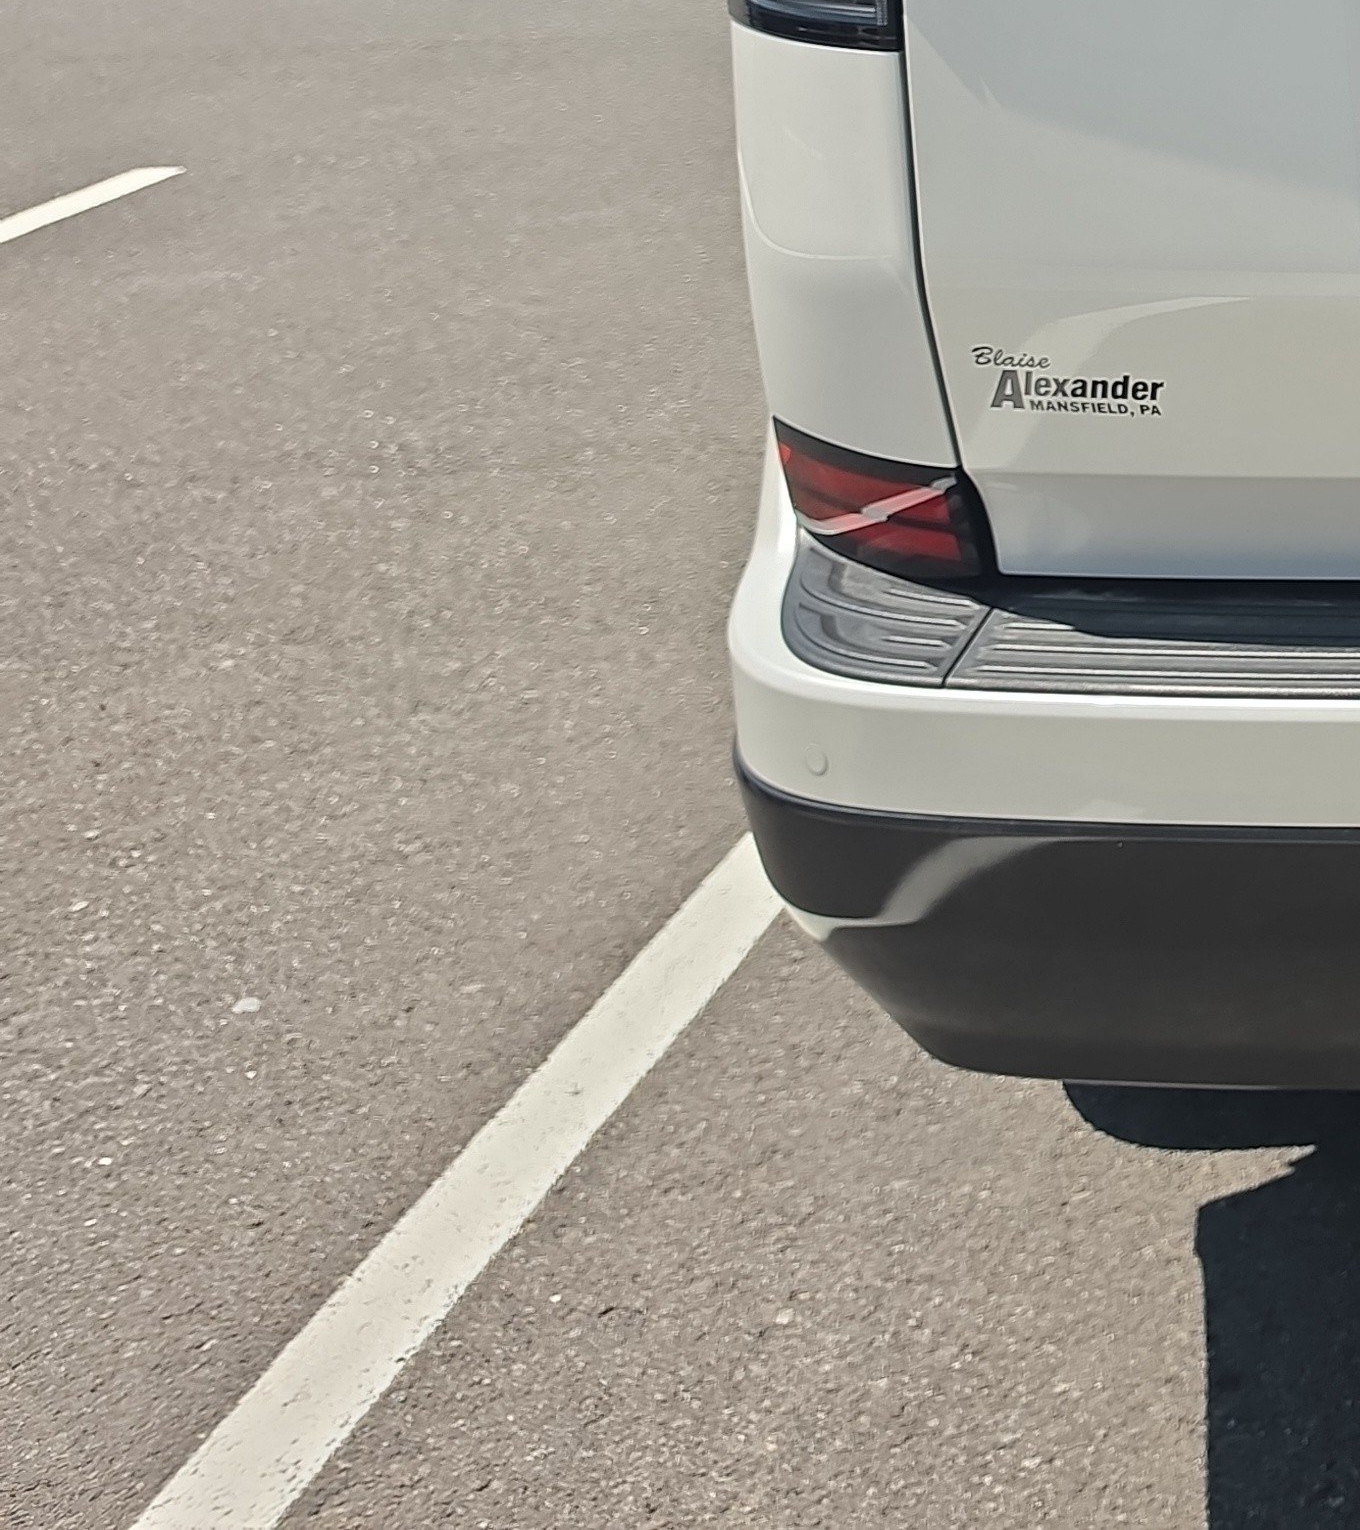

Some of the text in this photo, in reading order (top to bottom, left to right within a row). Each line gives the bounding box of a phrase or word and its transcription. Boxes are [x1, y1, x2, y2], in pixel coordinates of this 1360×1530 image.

[971, 346, 1051, 370] Blaise
[990, 370, 1165, 410] Alexander
[1029, 400, 1162, 418] MANSFIELD, PA
